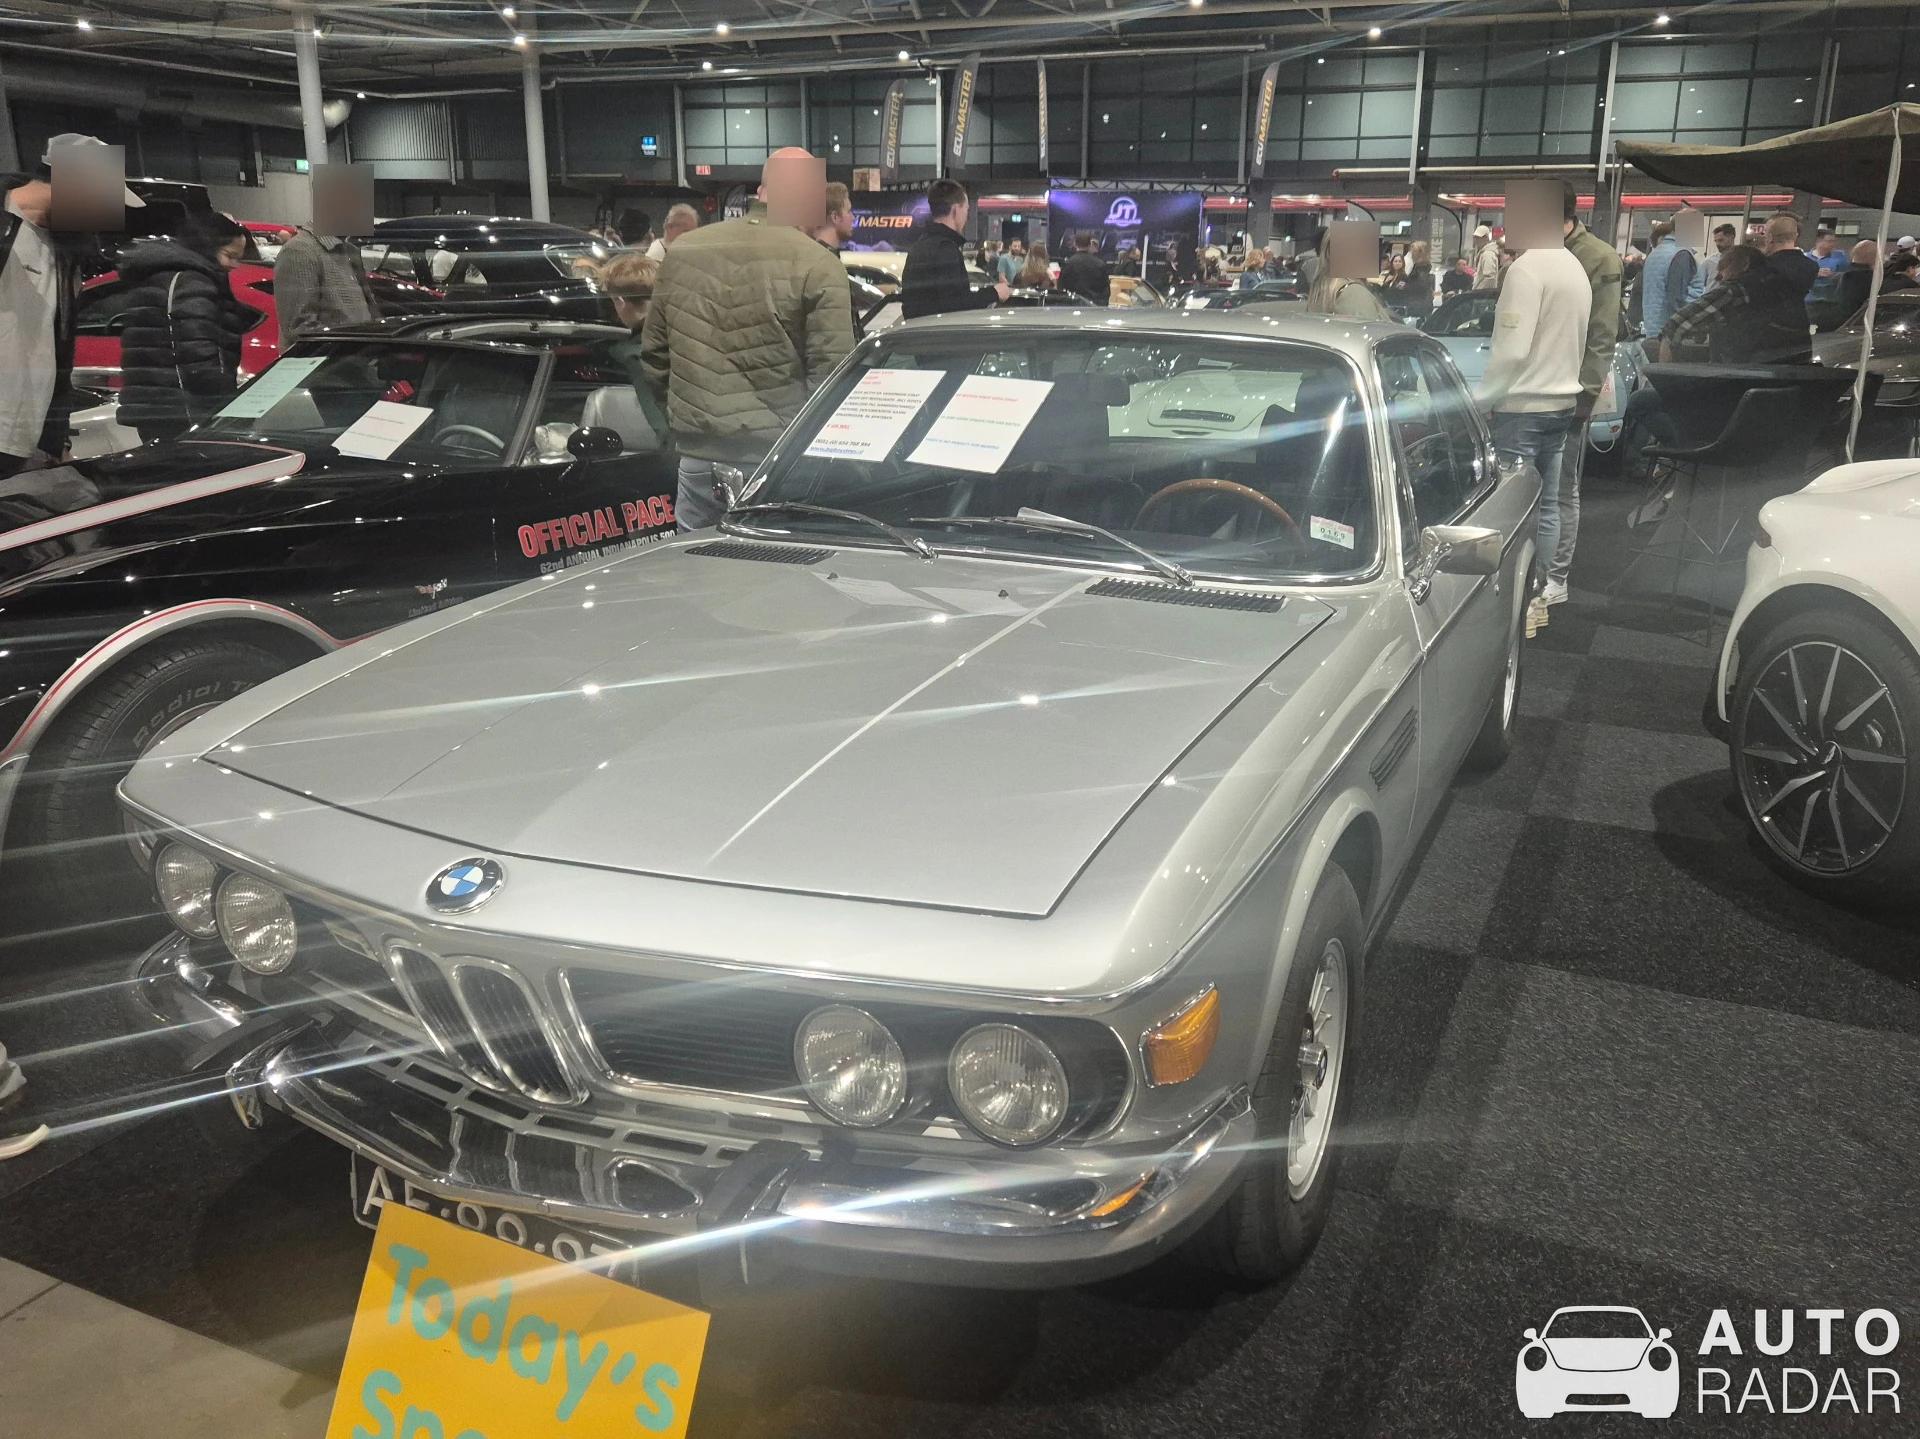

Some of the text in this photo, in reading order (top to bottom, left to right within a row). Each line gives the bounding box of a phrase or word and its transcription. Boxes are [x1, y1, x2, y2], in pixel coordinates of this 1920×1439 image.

[886, 91, 902, 169] ECUMASTER
[953, 69, 973, 157] ECUMASTER
[1256, 79, 1273, 166] ECUMASTER
[517, 493, 677, 558] OFFICIAL PACE
[540, 528, 676, 574] 62nd ANNUAL INDIANAPOLIS 500
[132, 680, 221, 749] Radial
[388, 1242, 680, 1432] Today's
